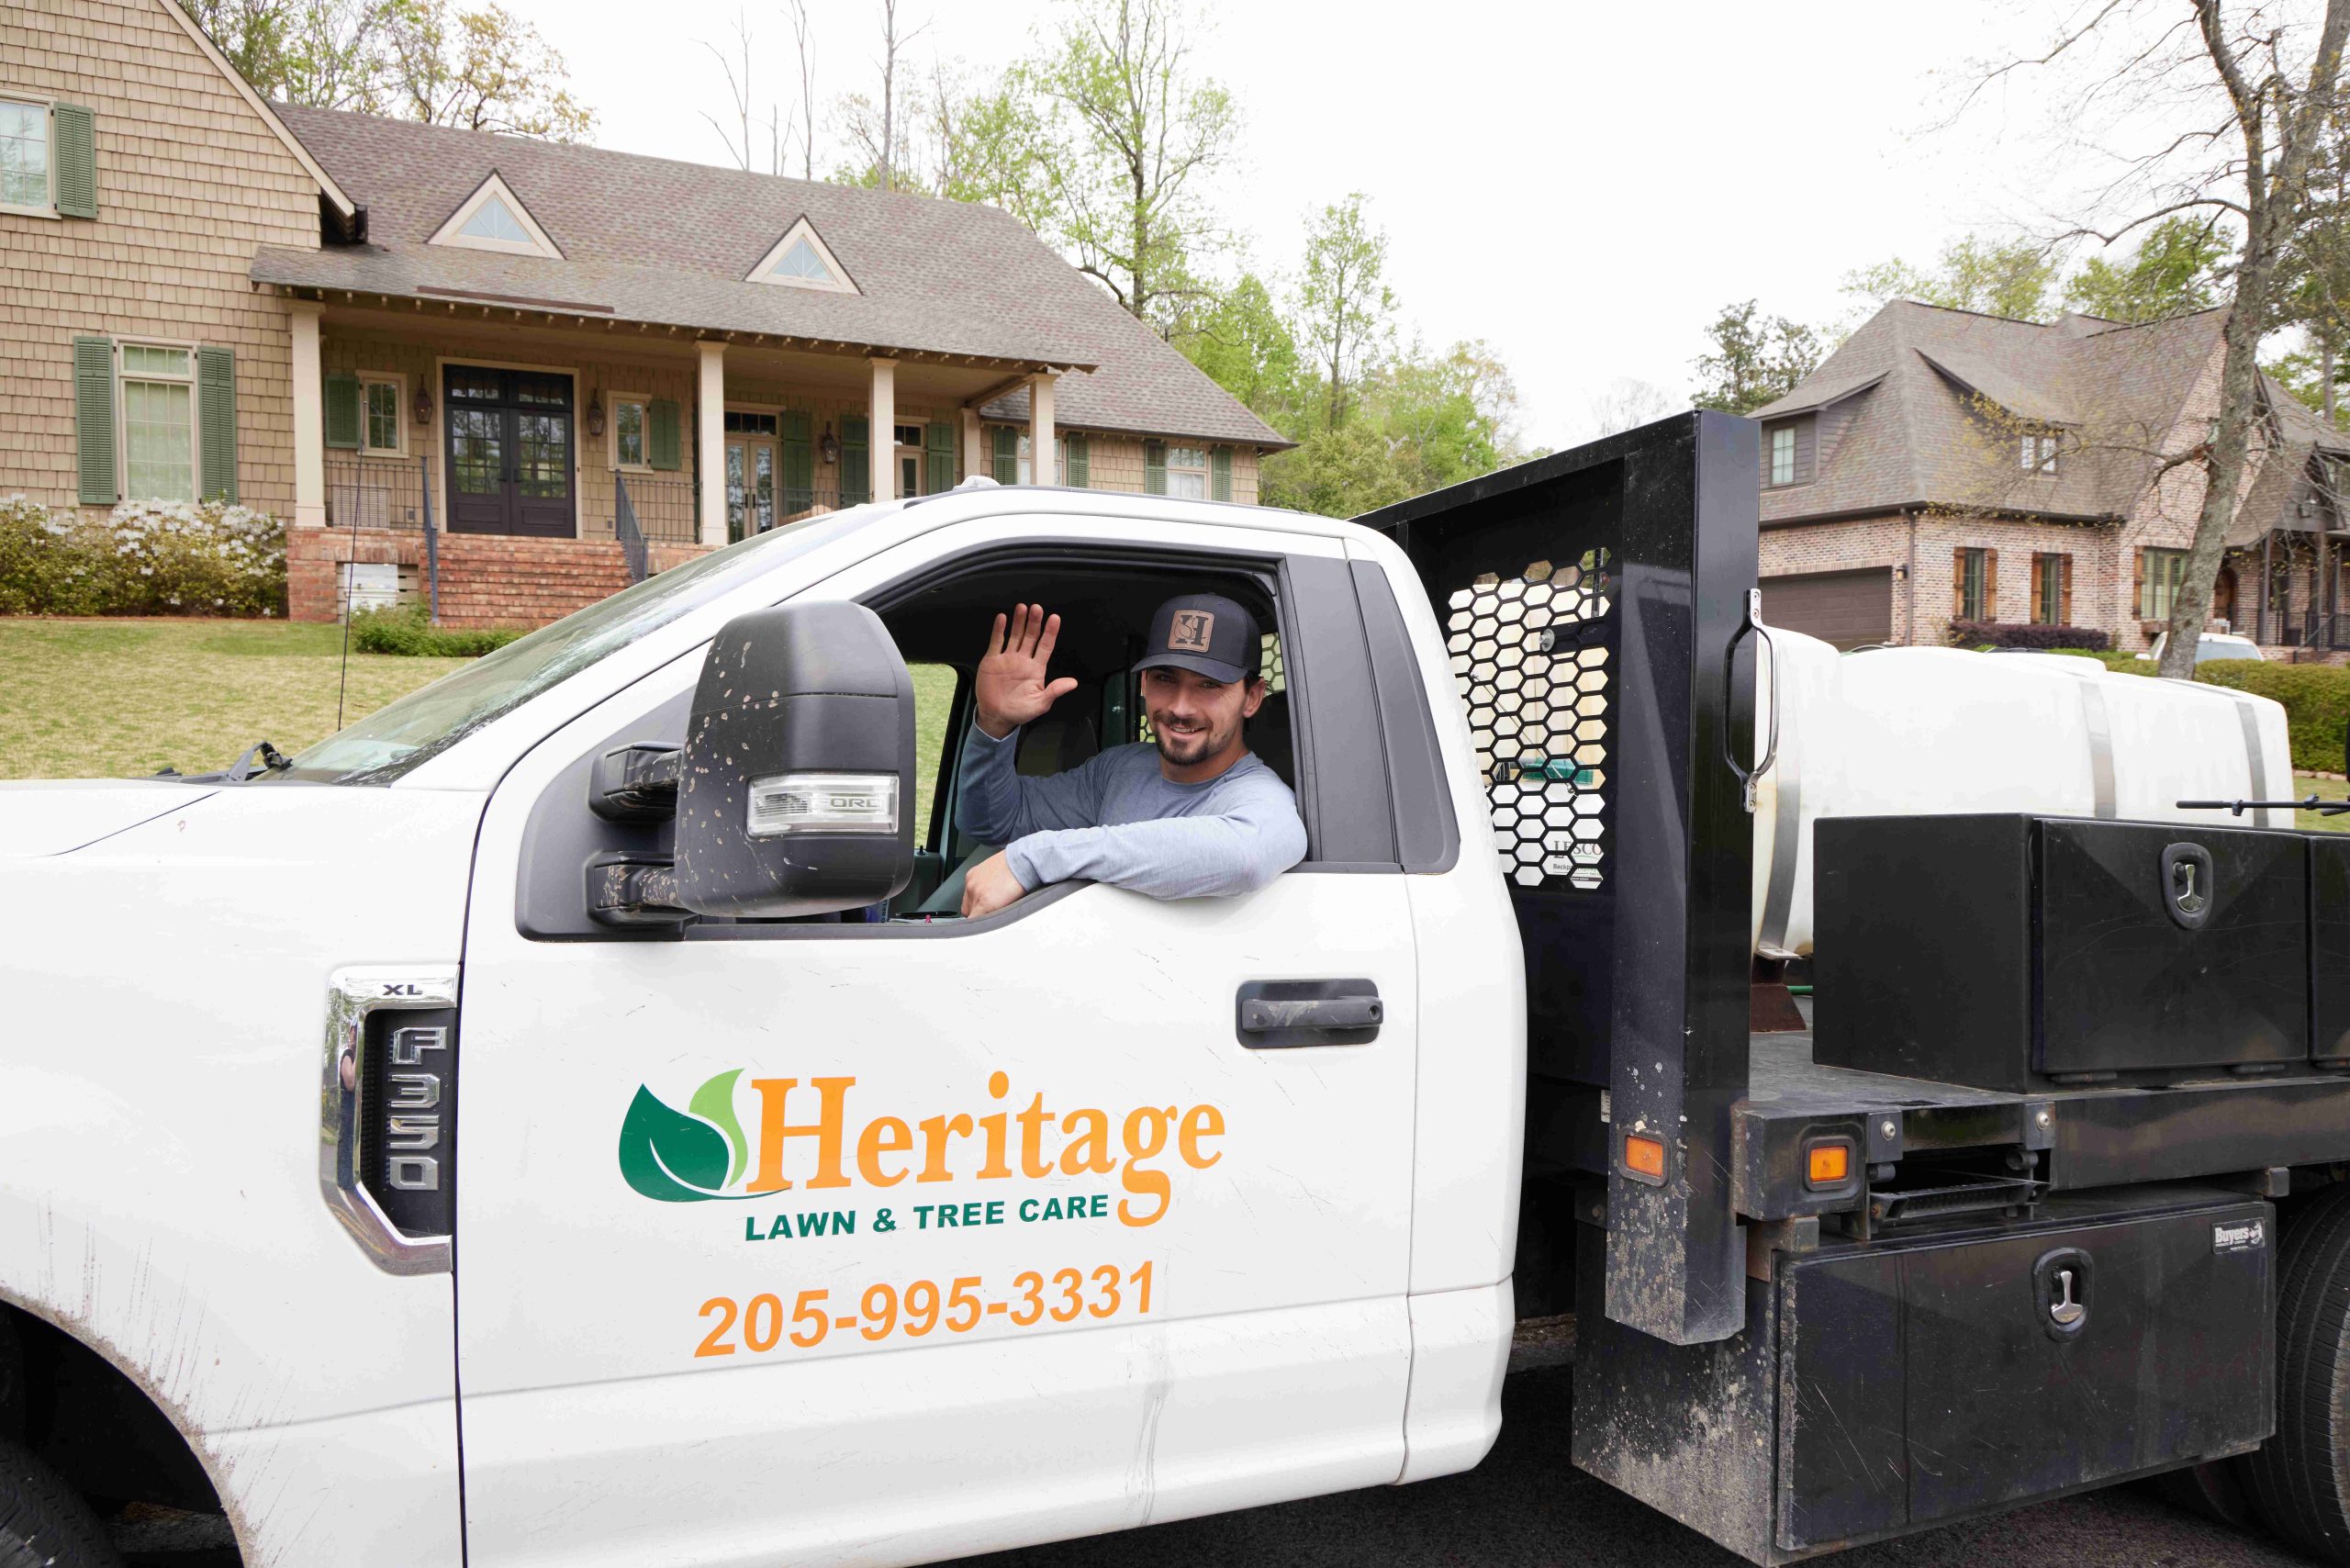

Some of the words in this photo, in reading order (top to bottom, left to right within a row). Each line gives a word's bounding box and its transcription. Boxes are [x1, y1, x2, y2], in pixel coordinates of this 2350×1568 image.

[820, 797, 880, 808] OR
[382, 984, 423, 996] XL
[388, 1026, 447, 1191] F350
[745, 1070, 1225, 1227] Heritage
[745, 1208, 856, 1242] LAWN
[873, 1206, 897, 1233] &
[913, 1201, 1005, 1230] TREE
[1019, 1194, 1110, 1224] CARE
[2214, 1226, 2249, 1246] Buyers
[694, 1260, 1154, 1358] 205-995-3331
